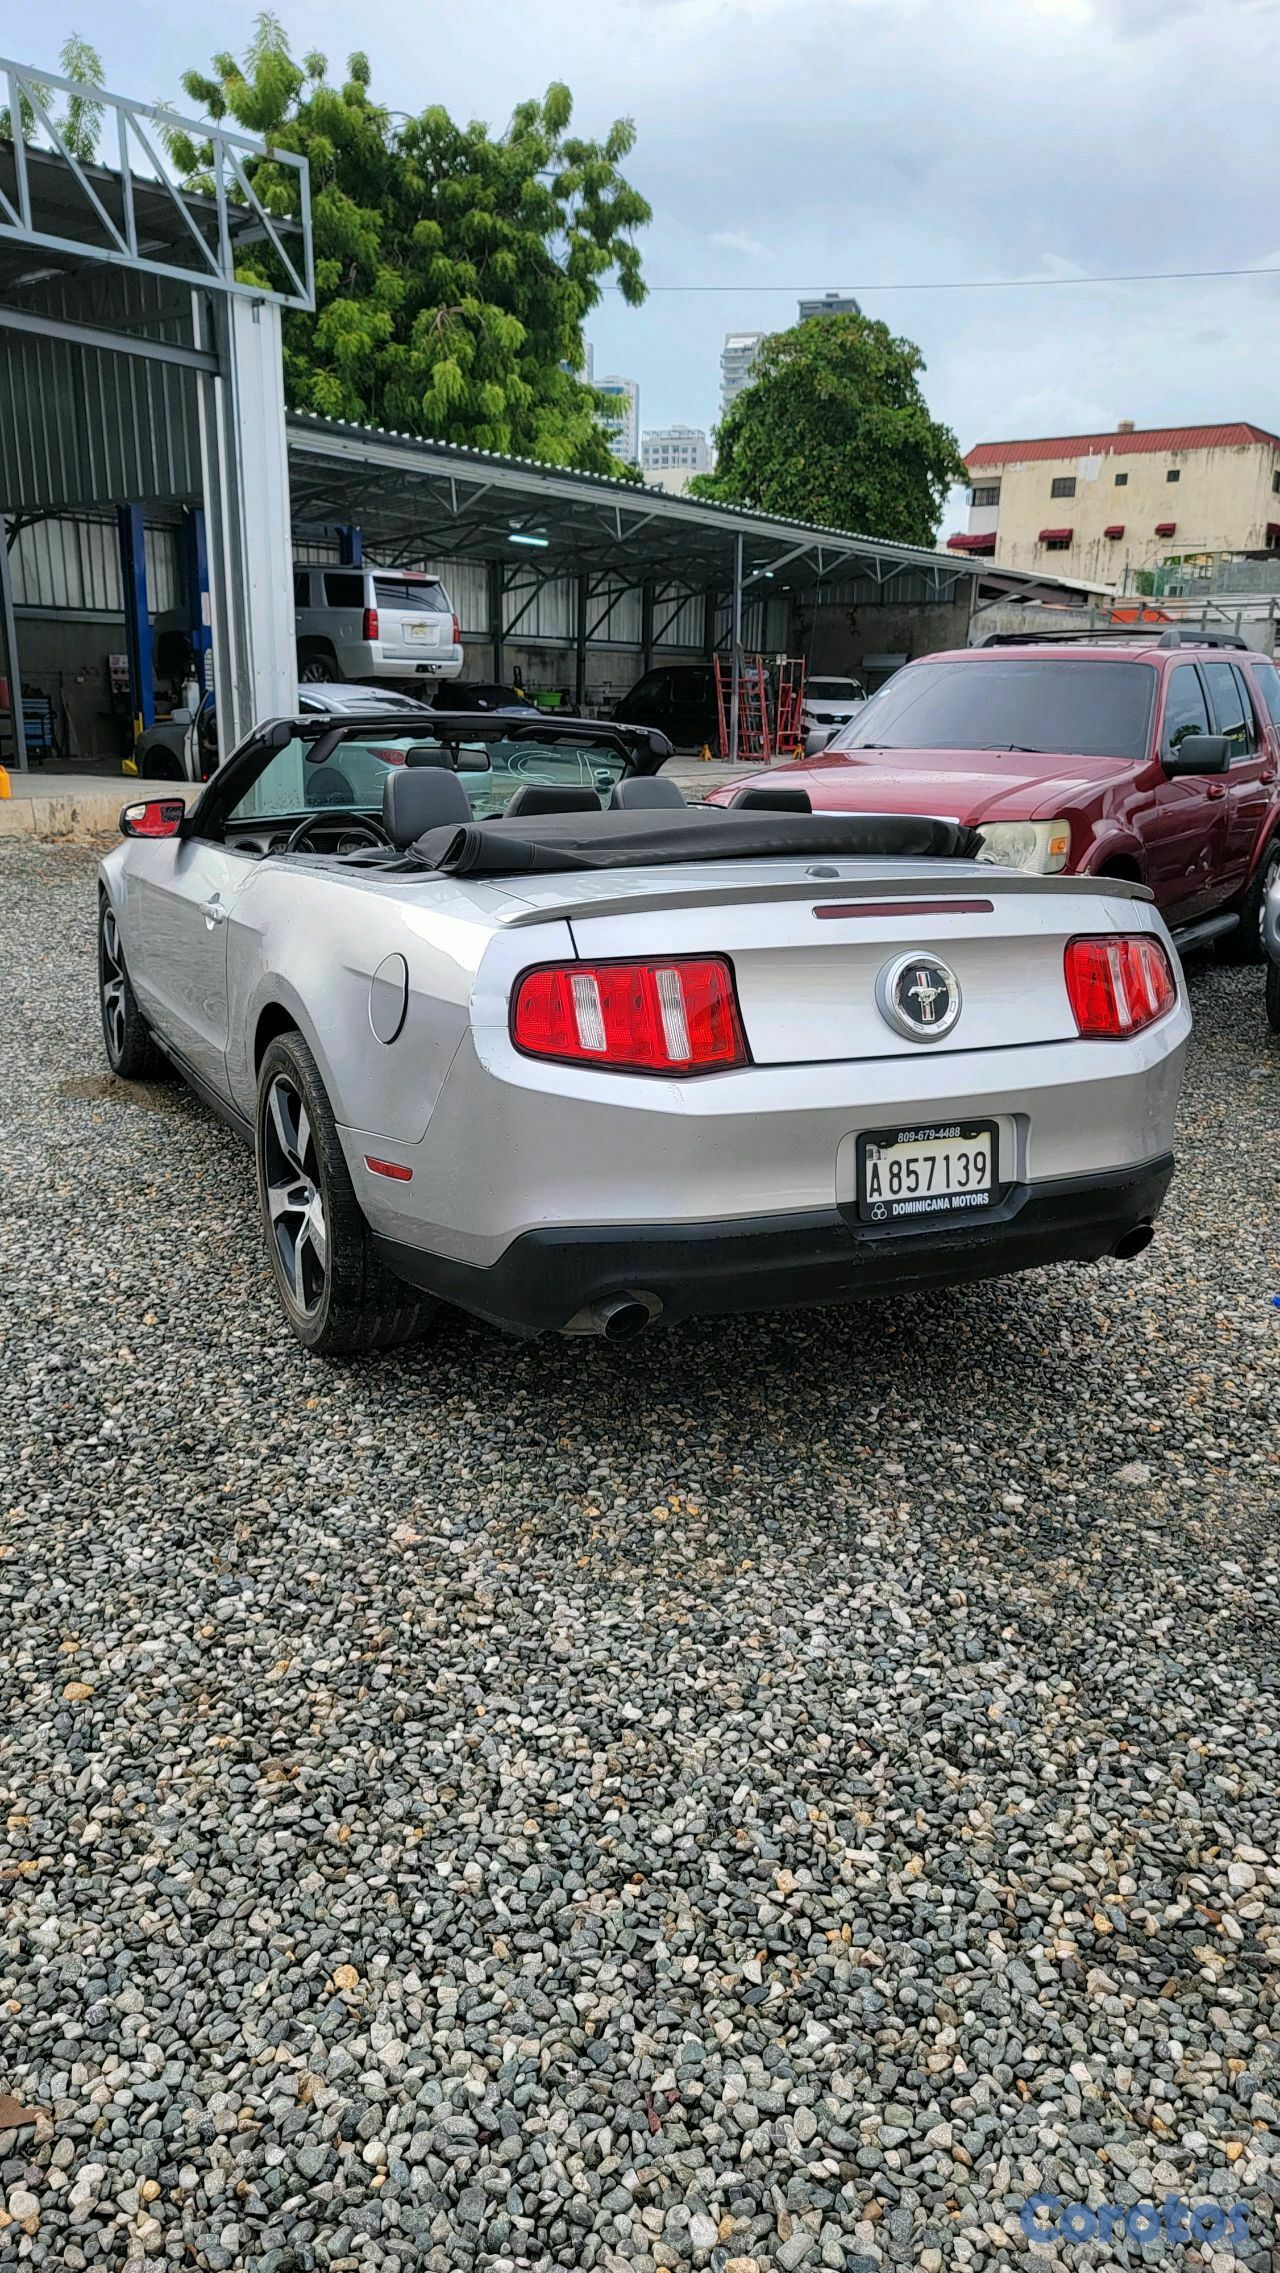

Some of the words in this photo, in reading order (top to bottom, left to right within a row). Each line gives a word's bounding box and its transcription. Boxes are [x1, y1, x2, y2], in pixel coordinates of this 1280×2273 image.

[898, 1127, 960, 1142] 809-679-4488
[869, 1151, 986, 1198] A857139
[892, 1199, 950, 1215] DOMINICANA
[952, 1193, 989, 1208] MOTORS
